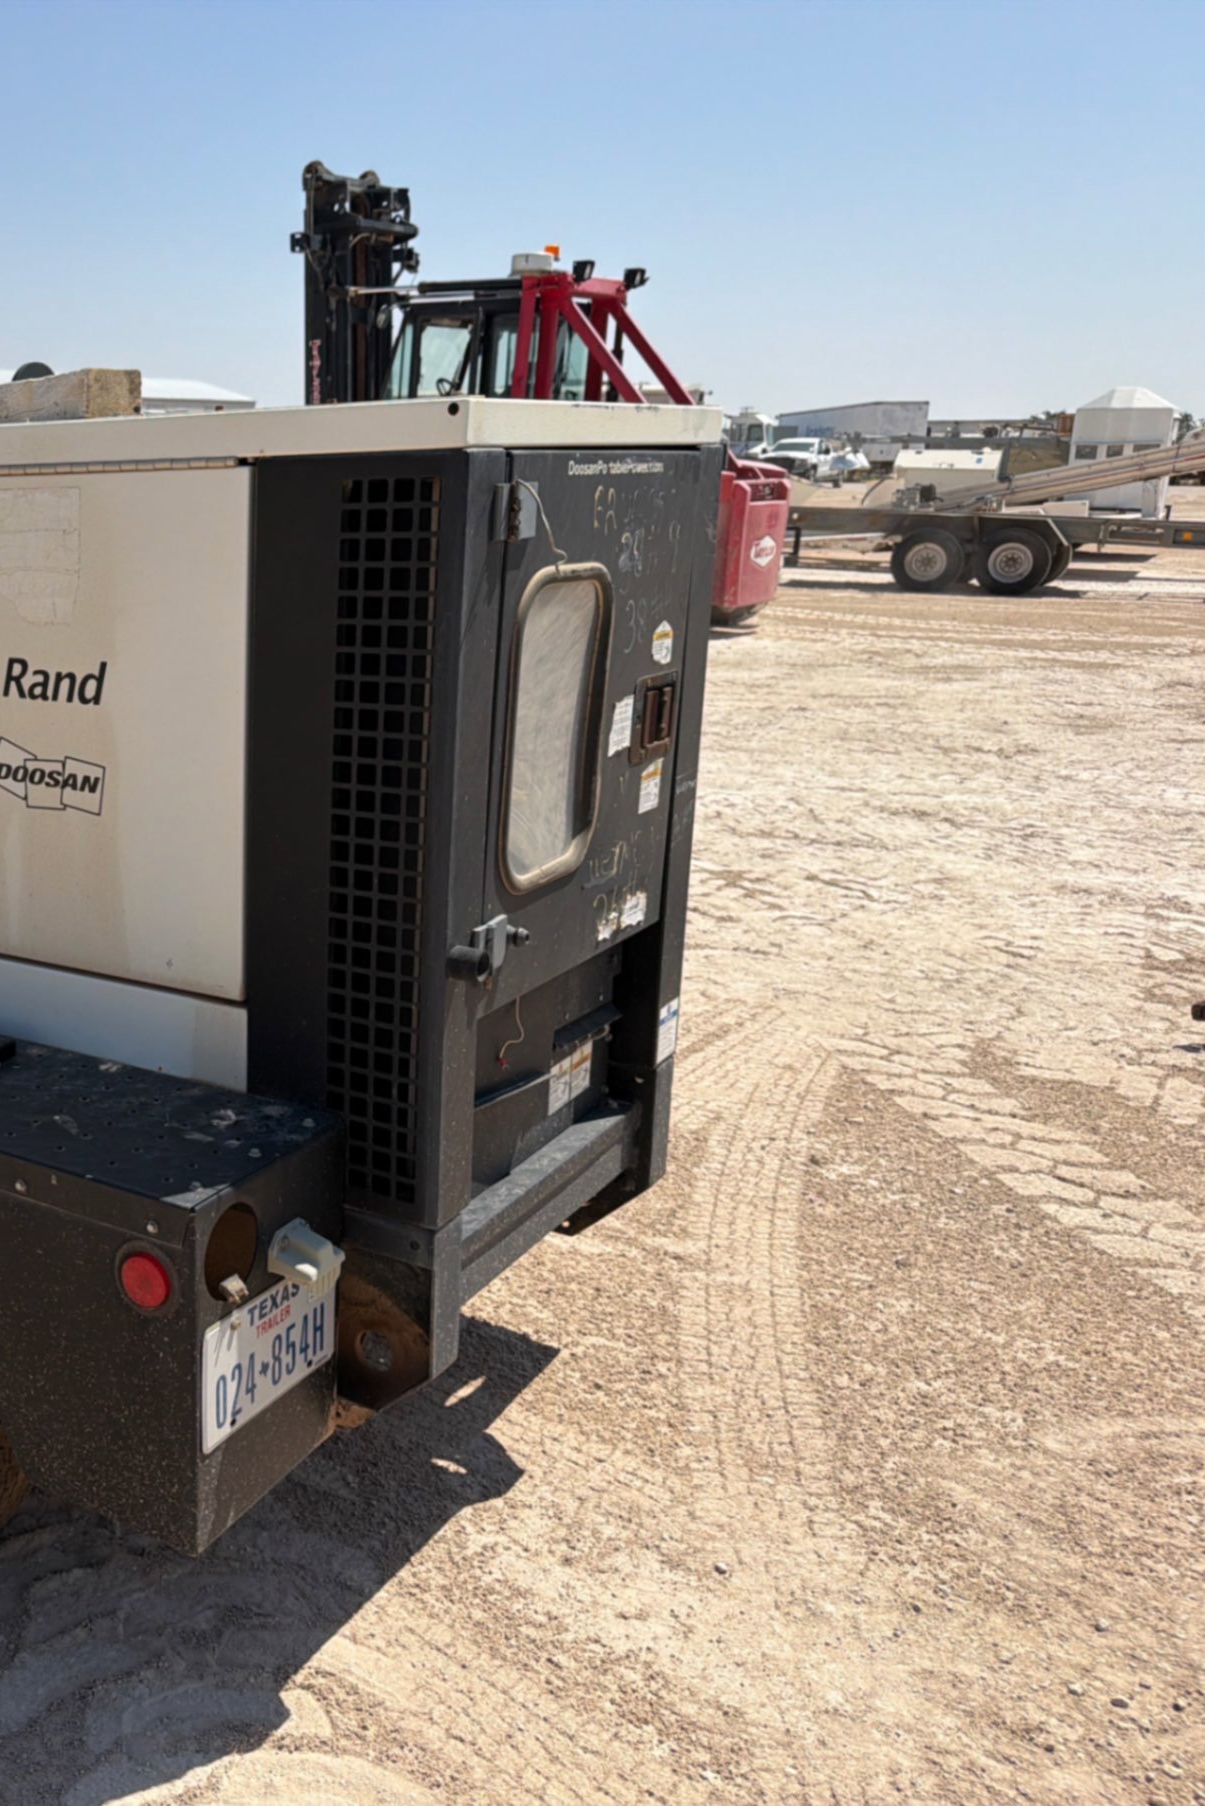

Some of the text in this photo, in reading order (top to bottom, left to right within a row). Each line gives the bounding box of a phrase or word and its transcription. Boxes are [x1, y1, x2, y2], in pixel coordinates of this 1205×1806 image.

[2, 657, 107, 705] Rand
[248, 1284, 300, 1326] TEXAS
[256, 1304, 291, 1338] TRAILER
